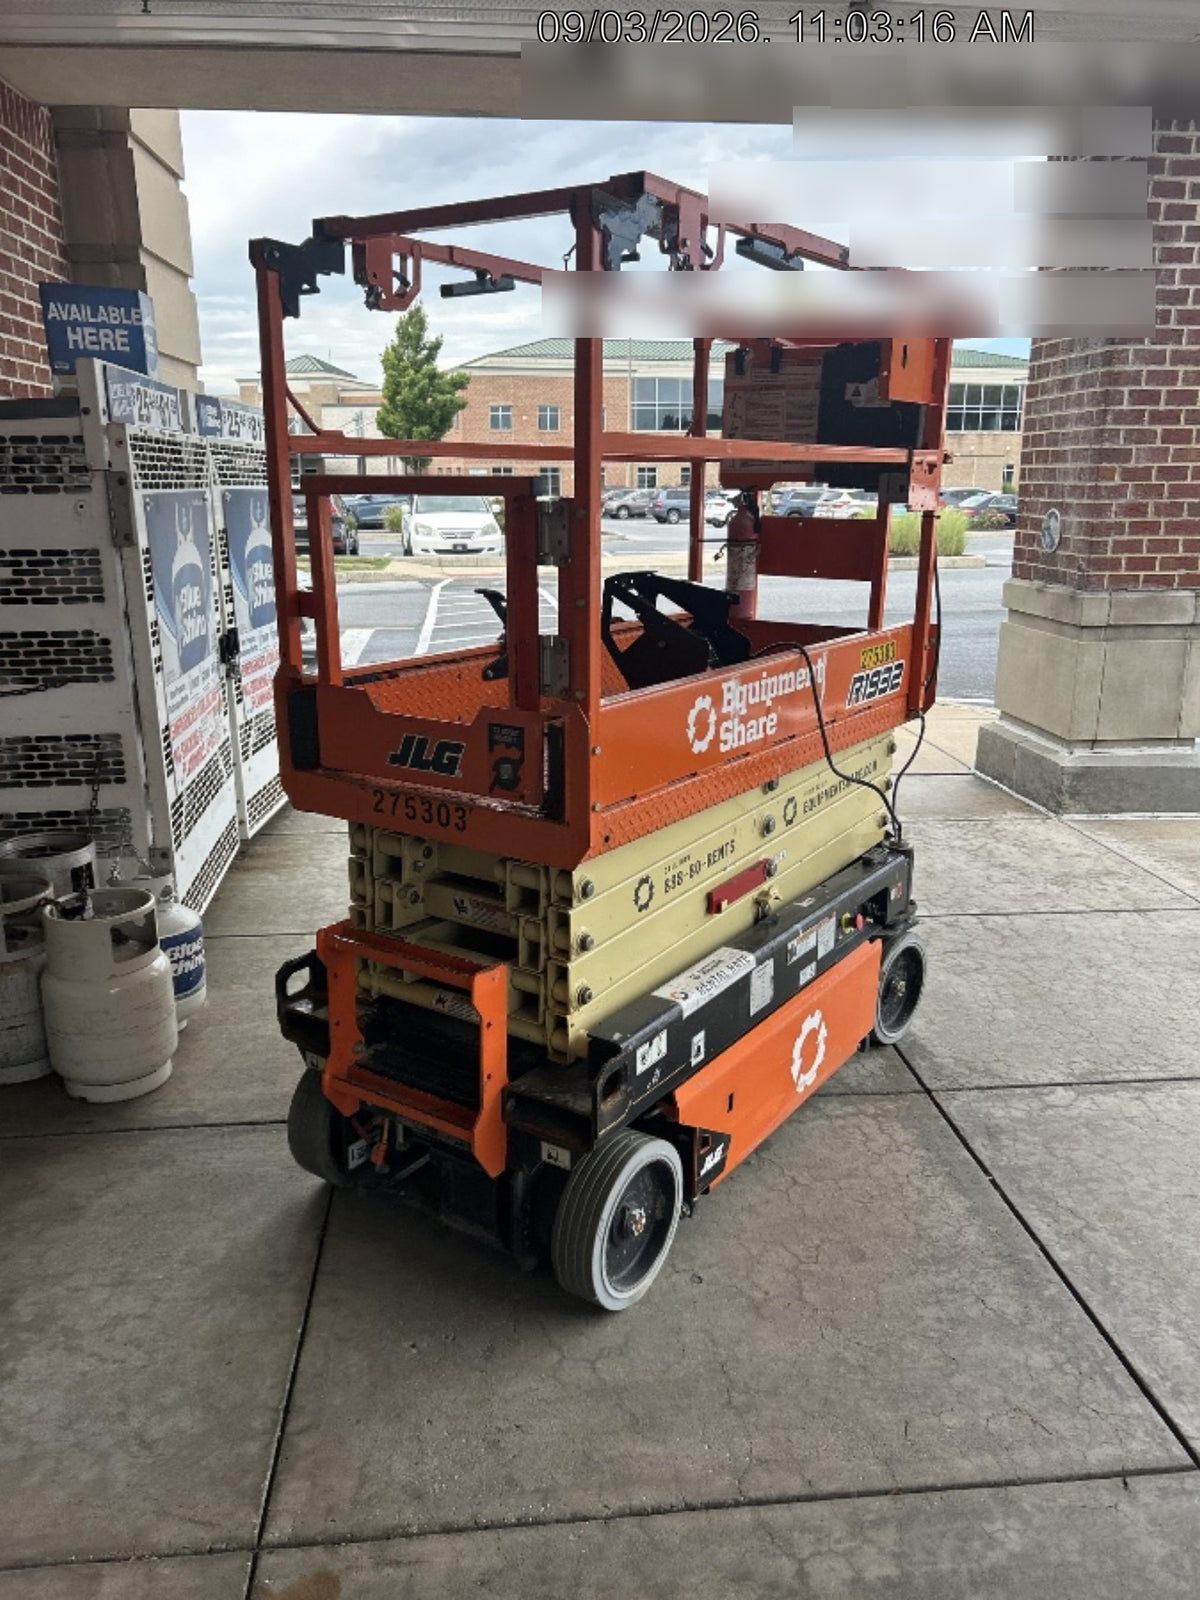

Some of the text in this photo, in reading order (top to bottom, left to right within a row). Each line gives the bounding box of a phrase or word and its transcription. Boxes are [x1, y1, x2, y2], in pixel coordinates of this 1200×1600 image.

[47, 302, 143, 326] AVAILABLE
[67, 326, 130, 353] HERE
[721, 657, 826, 715] Equipment
[719, 712, 778, 753] Share
[387, 732, 467, 778] JLG
[372, 789, 468, 832] 275303
